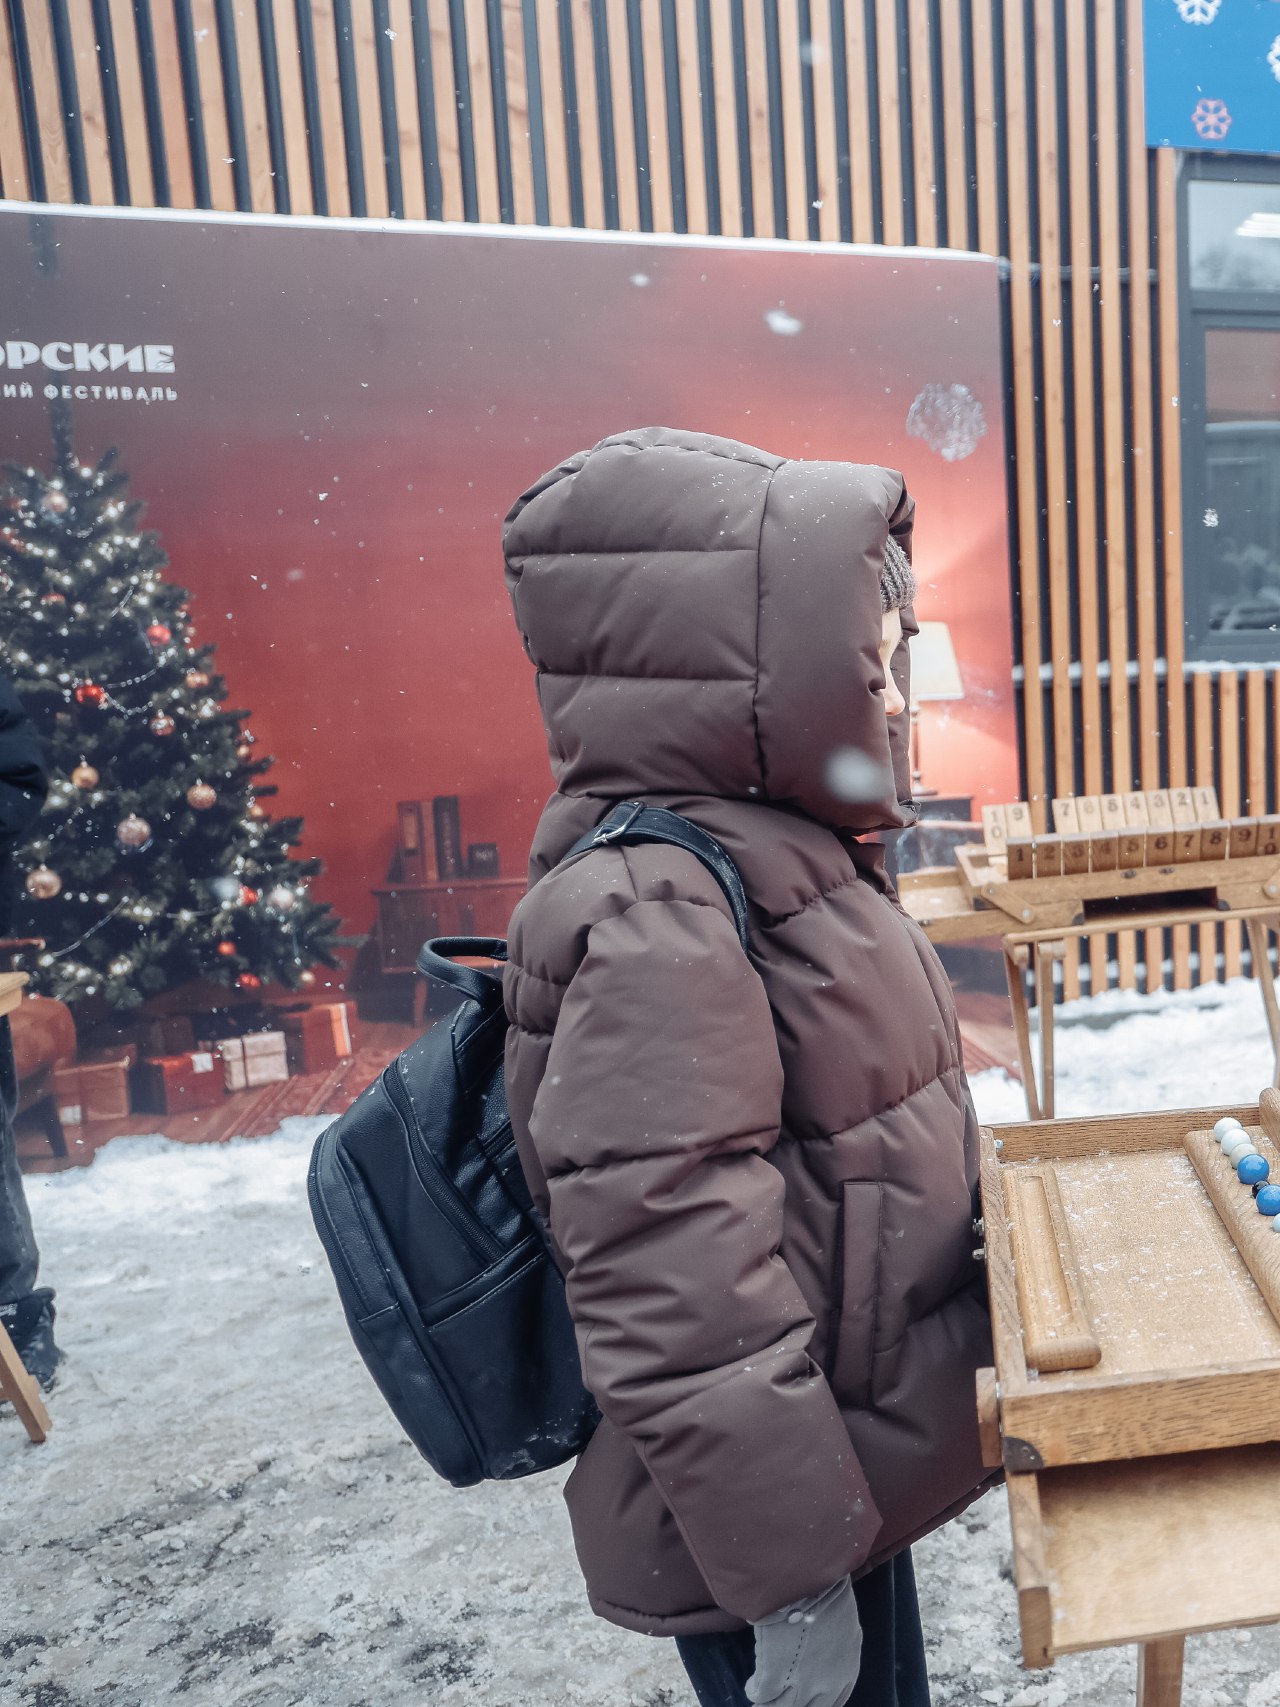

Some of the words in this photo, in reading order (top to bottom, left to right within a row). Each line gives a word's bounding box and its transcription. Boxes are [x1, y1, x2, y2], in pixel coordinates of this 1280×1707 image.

[0, 340, 176, 374] РСКИЕ
[2, 381, 34, 399] ИЙ
[43, 384, 178, 402] ФЕСТИВАЛЬ
[1059, 801, 1071, 817] 7
[1015, 847, 1024, 862] 1
[1154, 835, 1168, 850] 6
[1183, 833, 1195, 848] 7
[1209, 830, 1223, 845] 8
[1238, 827, 1252, 842] 9
